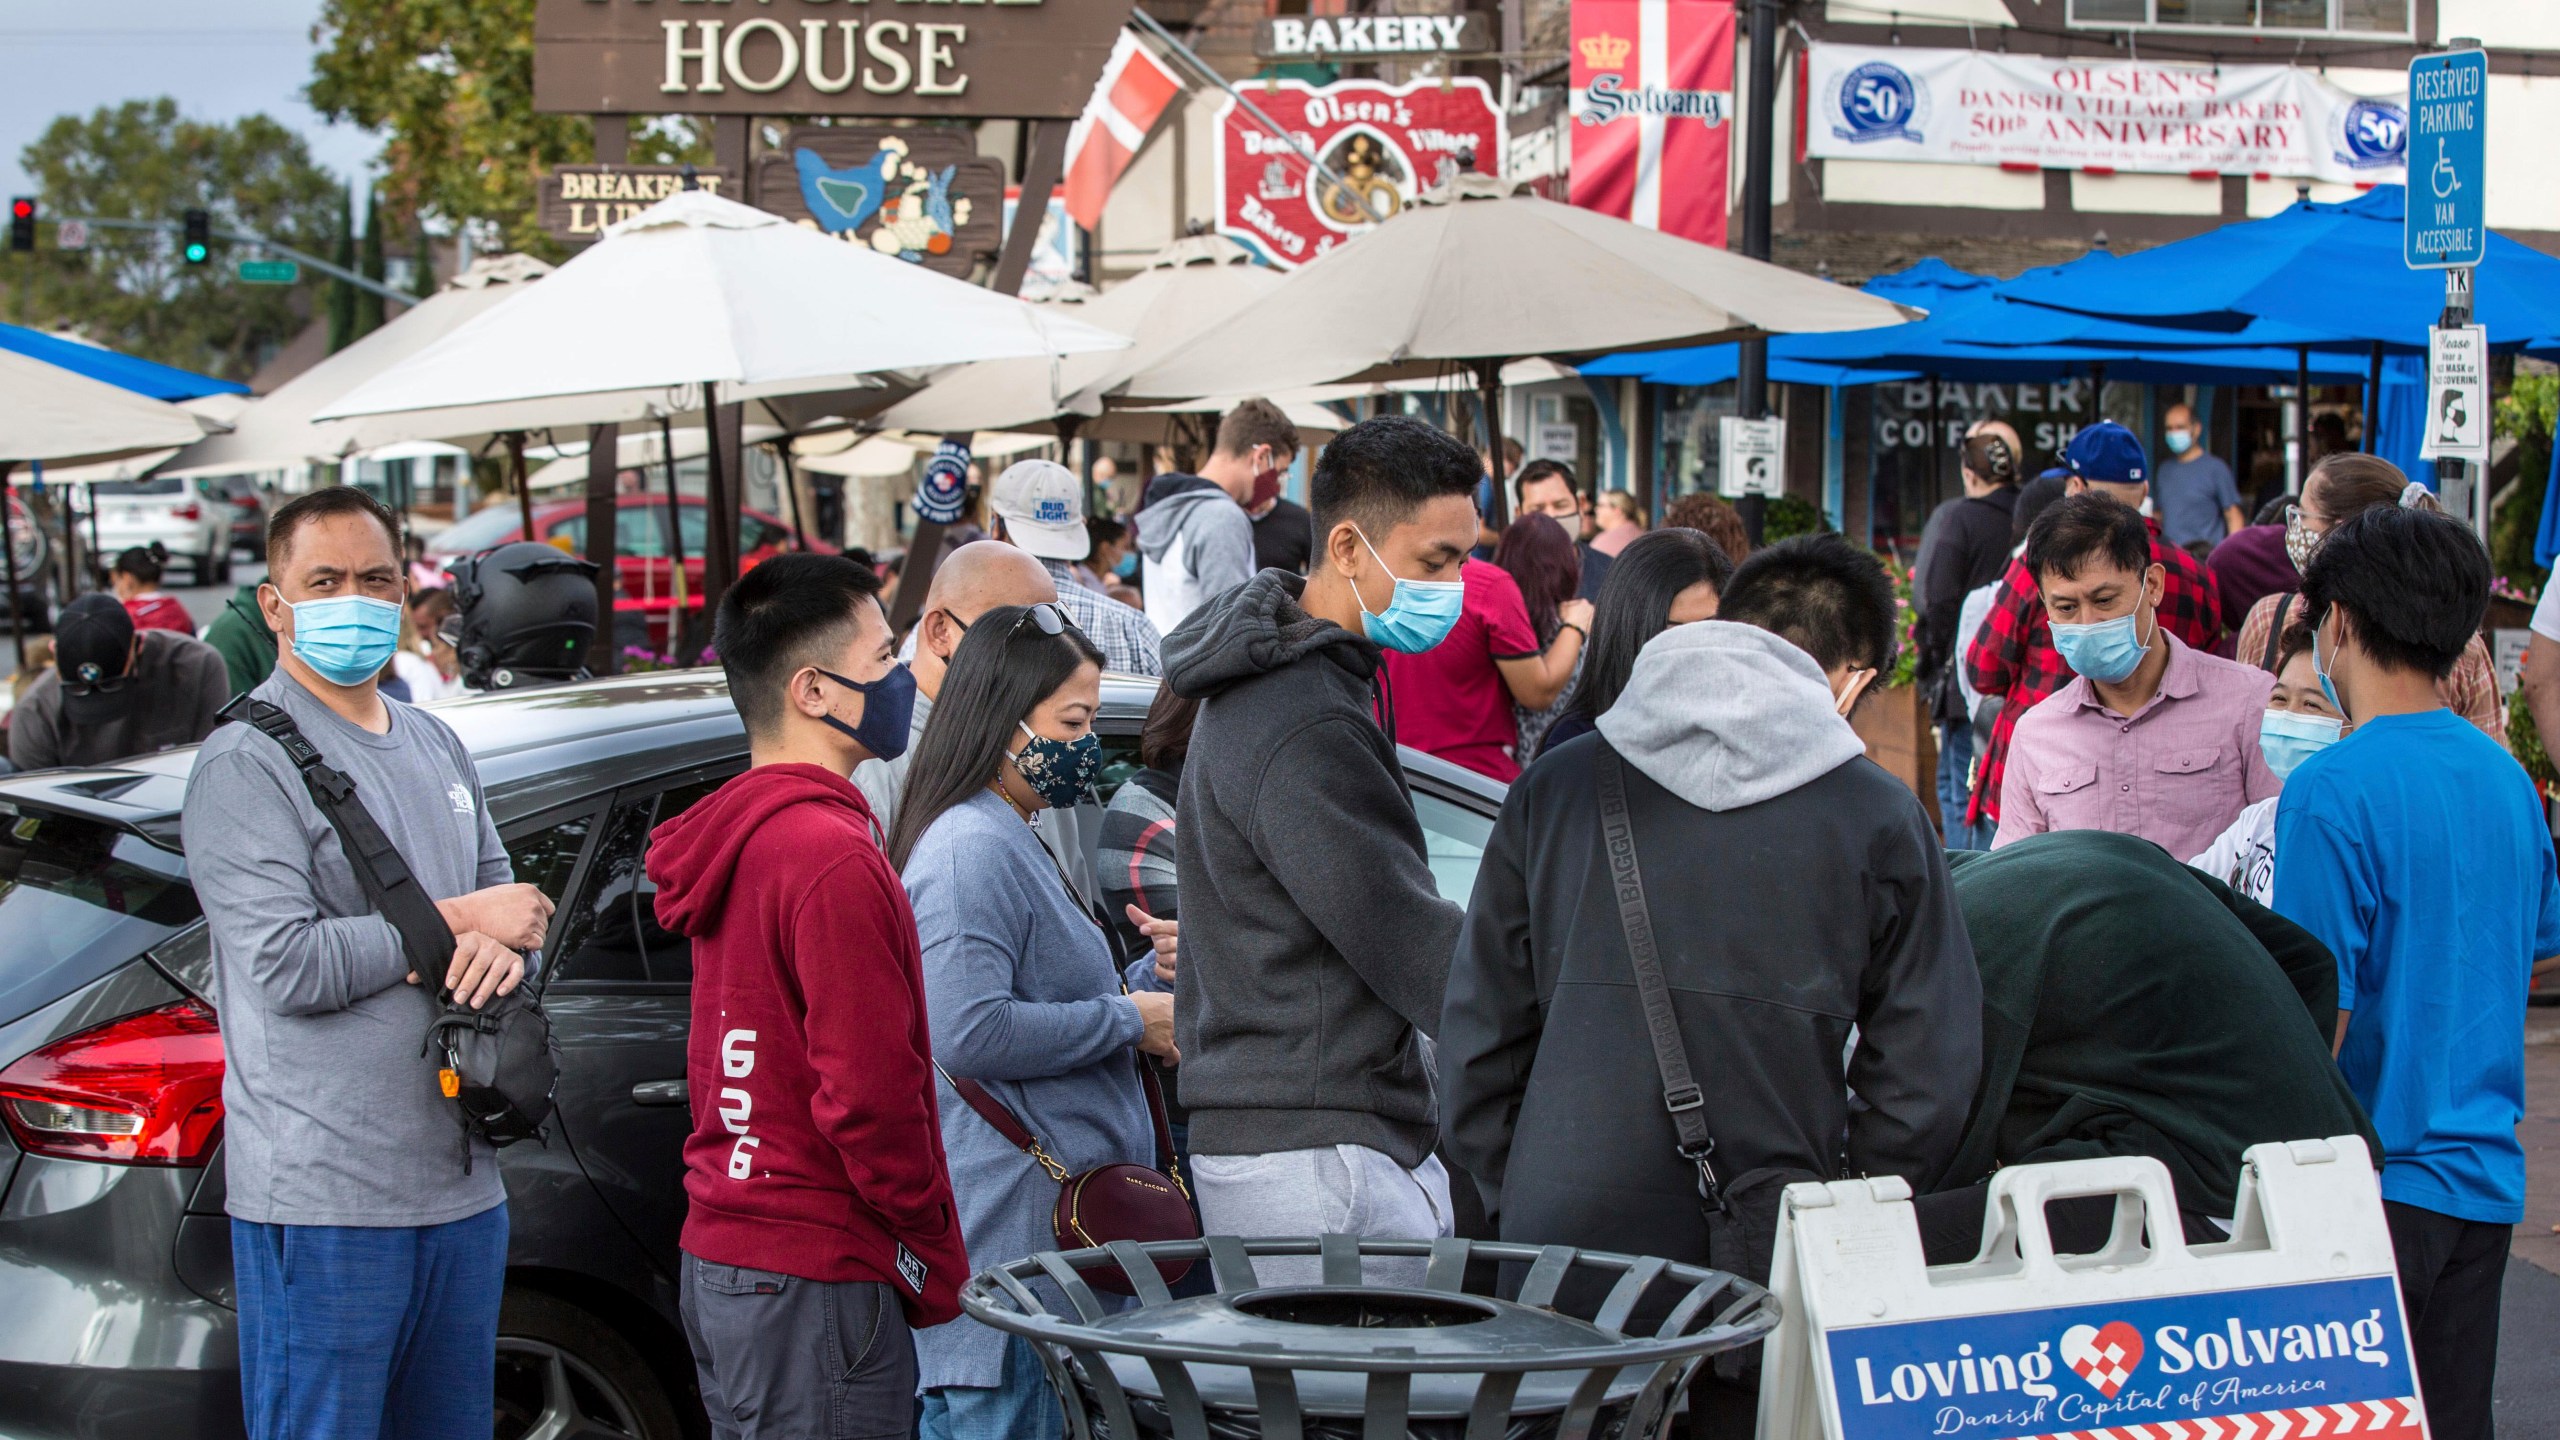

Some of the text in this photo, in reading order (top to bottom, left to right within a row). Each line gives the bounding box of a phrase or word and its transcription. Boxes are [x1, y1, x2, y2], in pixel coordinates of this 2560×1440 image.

[1271, 15, 1467, 53] BAKERY
[660, 17, 969, 95] HOUSE
[2051, 66, 2218, 96] OLSEN'S
[2415, 65, 2479, 102] RESERVED
[1304, 96, 1413, 127] Olsen's
[1576, 74, 1723, 128] Solvang
[1855, 79, 1900, 121] 50
[1958, 89, 2304, 122] DANISH VILLAGE BAKERY
[2419, 99, 2474, 135] PARKING
[1969, 111, 2292, 149] 50th ANNIVERSARY
[2359, 110, 2401, 151] 50
[560, 172, 722, 200] BREAKFAT
[2434, 202, 2455, 227] VAN
[2415, 227, 2474, 255] ACCESSIBLE
[2443, 375, 2478, 386] COVERING
[2445, 363, 2466, 373] MASK
[1035, 510, 1069, 521] LIGHT
[1041, 501, 1065, 511] BUD
[1607, 822, 1641, 905] BAGGU
[1624, 909, 1665, 993] BAGGU
[1646, 1001, 1689, 1081] BAGGU
[1126, 1176, 1168, 1193] MARC JACOBS
[1855, 1308, 2390, 1405] Loving Solvang
[1932, 1376, 2327, 1436] Danish Capital of America
